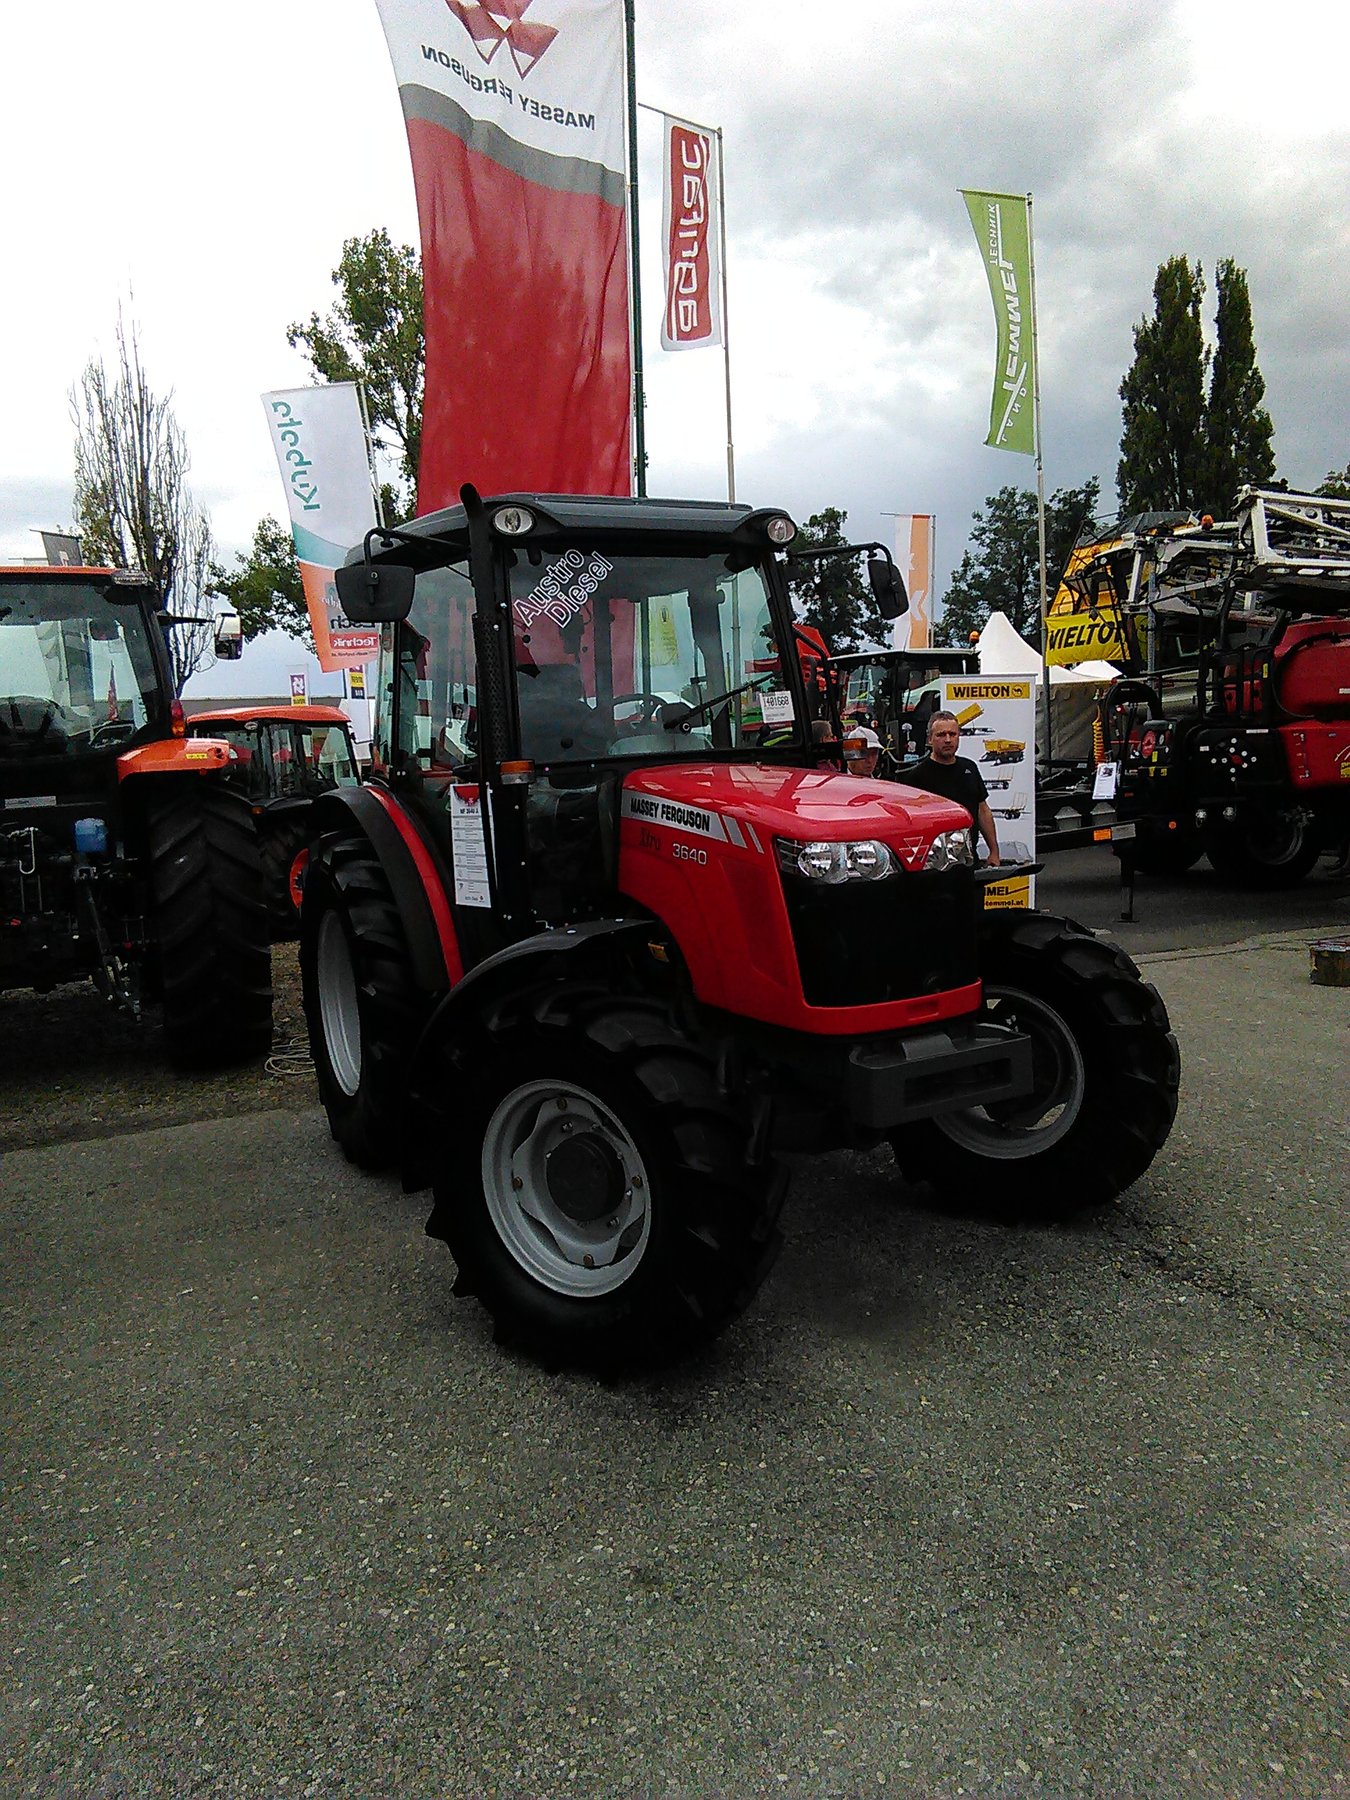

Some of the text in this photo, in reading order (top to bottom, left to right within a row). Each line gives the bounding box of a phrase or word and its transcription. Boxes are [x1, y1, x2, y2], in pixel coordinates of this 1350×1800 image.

[513, 549, 585, 627] Austro
[544, 551, 614, 629] Diesel
[953, 685, 1010, 698] WIELTON
[630, 797, 712, 833] MASSEY FERGUSON
[672, 842, 708, 866] 3640
[984, 886, 1014, 896] MEL
